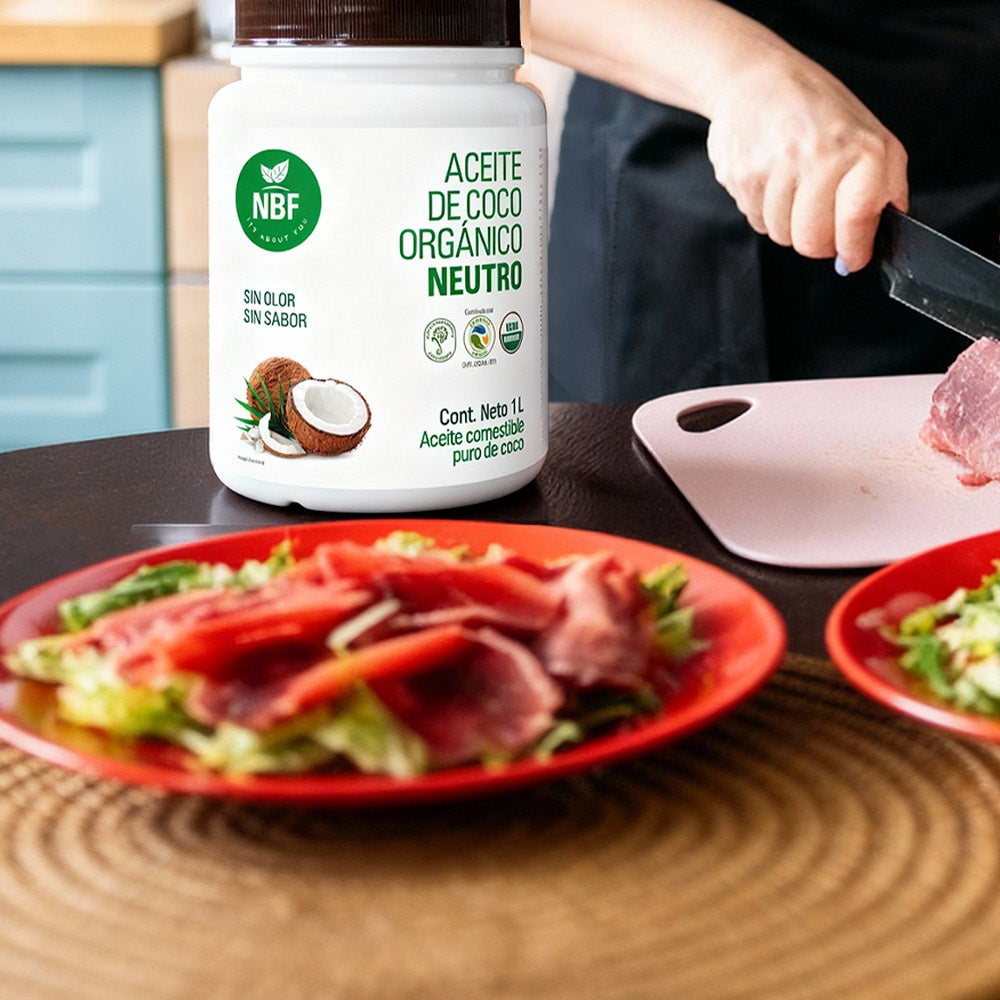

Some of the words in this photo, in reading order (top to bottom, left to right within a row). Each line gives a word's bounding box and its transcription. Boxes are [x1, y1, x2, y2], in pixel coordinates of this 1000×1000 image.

[444, 151, 522, 183] ACEITE
[252, 191, 300, 221] NBF
[428, 190, 461, 221] DE
[466, 187, 522, 220] COCO
[399, 219, 523, 260] ORGÁNICO
[428, 260, 523, 297] NEUTRO
[243, 288, 262, 305] SIN
[263, 290, 296, 308] OLOR
[243, 308, 262, 325] SIN
[263, 310, 308, 328] SABOR
[439, 406, 477, 426] Cont.
[480, 402, 508, 421] Neto
[419, 428, 464, 449] Aceite
[465, 417, 526, 444] comestible
[452, 446, 482, 467] puro
[483, 441, 499, 459] de
[500, 437, 525, 456] coco
